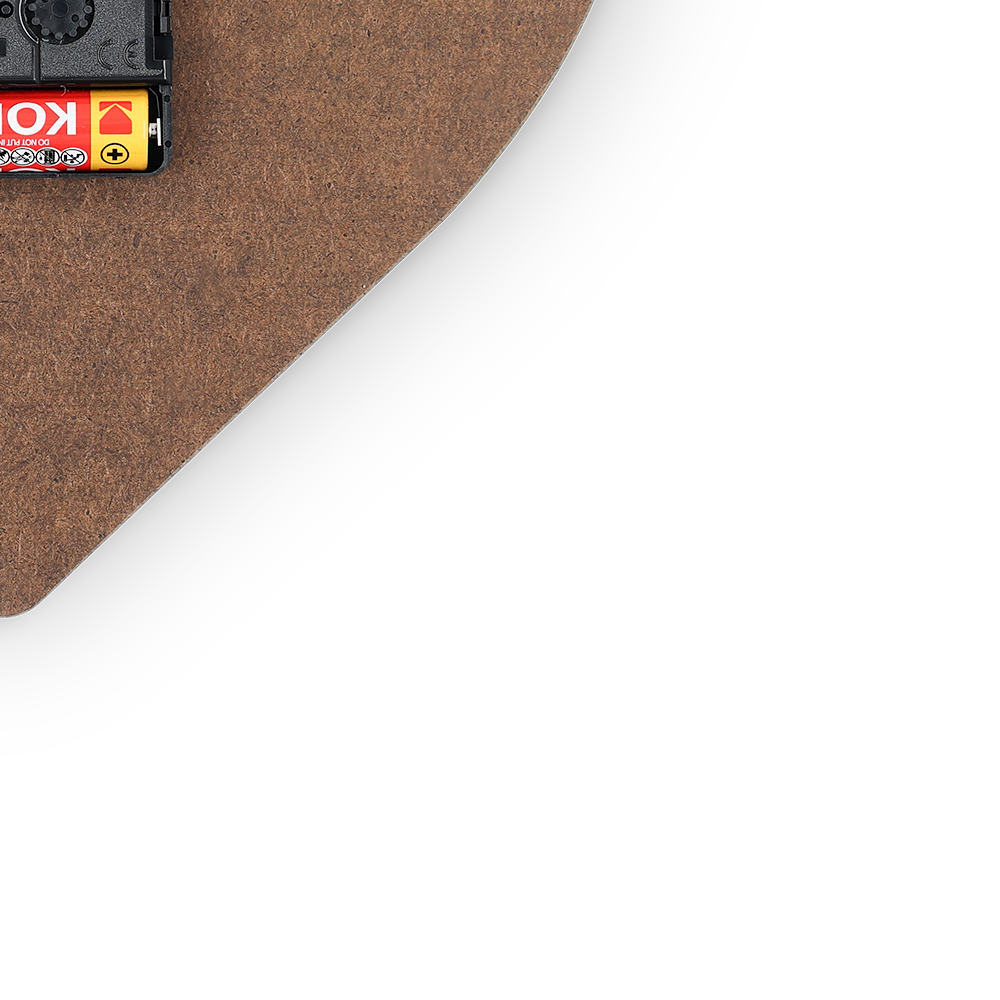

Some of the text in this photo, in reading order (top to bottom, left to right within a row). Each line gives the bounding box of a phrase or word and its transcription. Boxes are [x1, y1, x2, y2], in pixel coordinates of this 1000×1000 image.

[6, 138, 21, 146] PUT
[21, 138, 37, 146] NOT
[37, 138, 50, 146] DO
